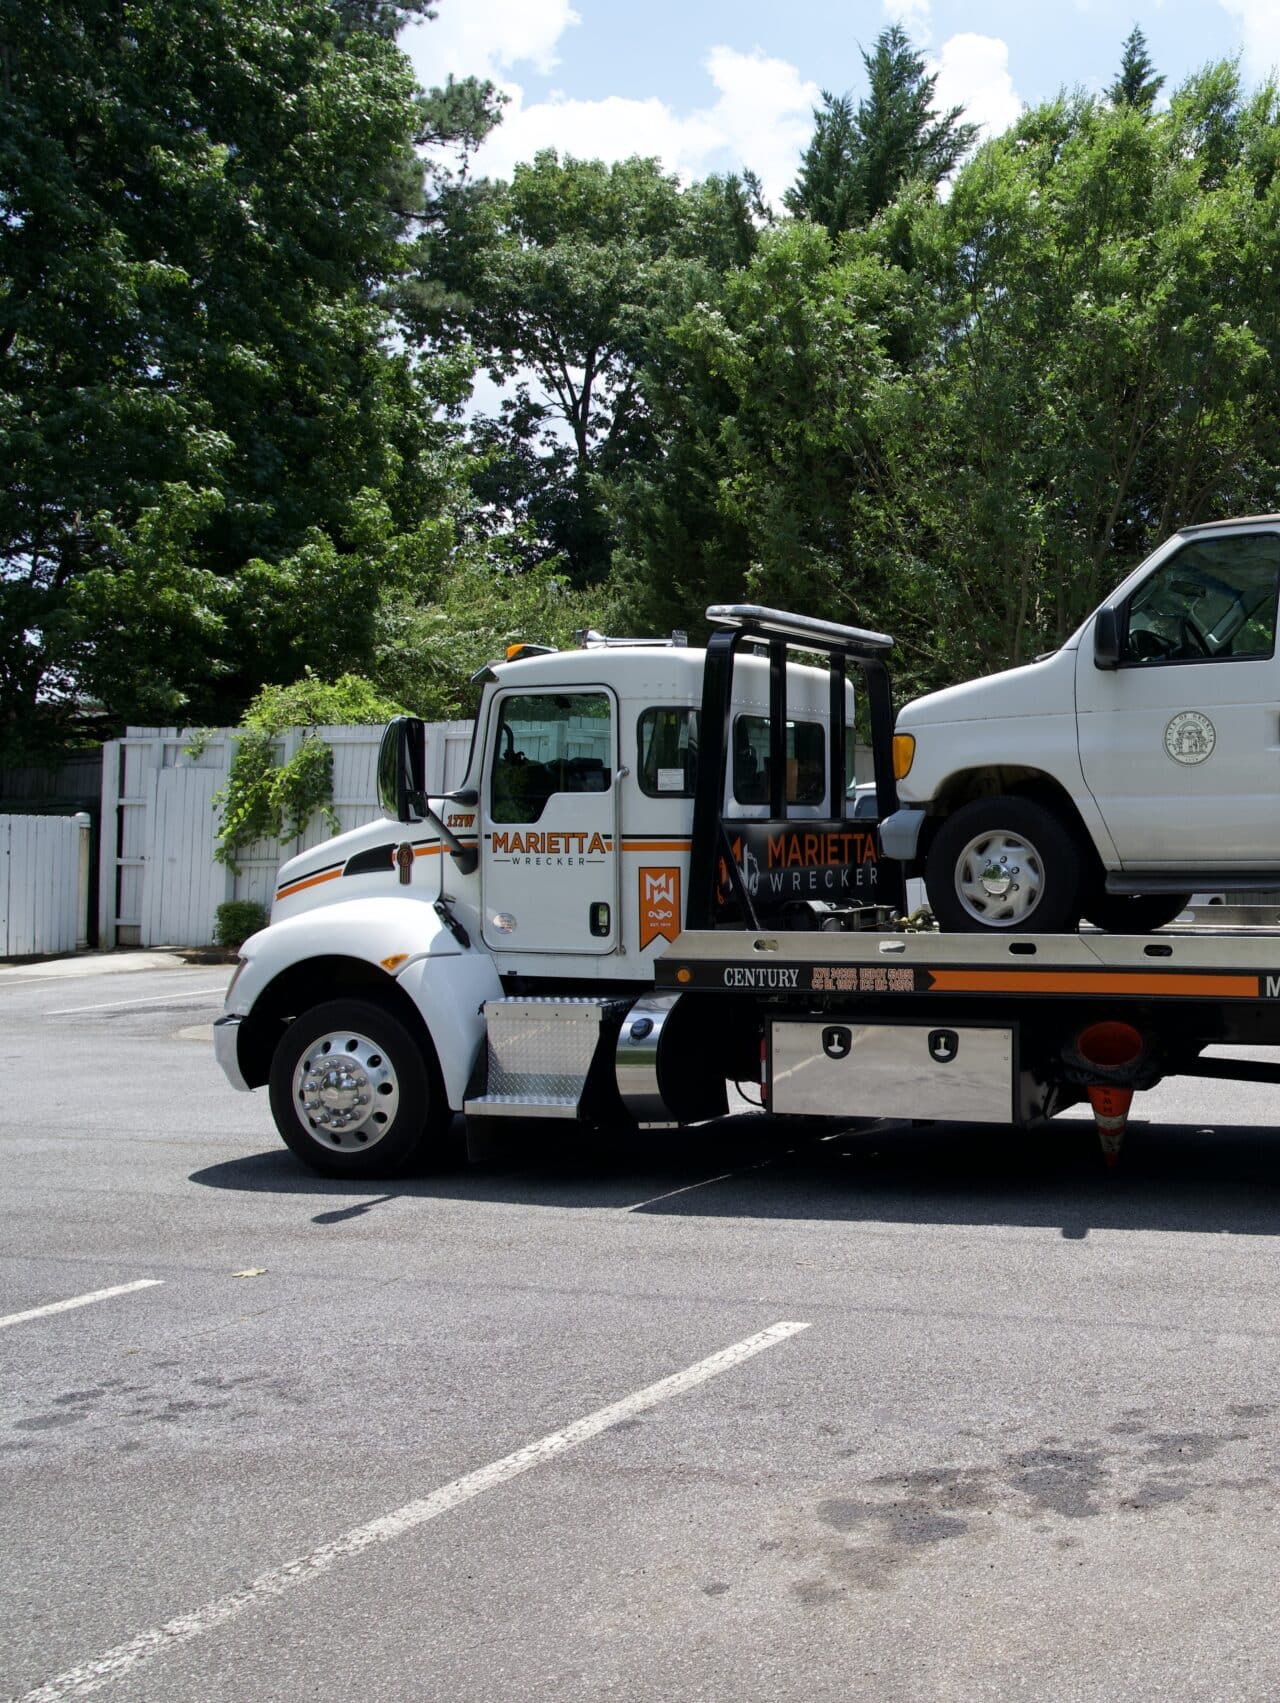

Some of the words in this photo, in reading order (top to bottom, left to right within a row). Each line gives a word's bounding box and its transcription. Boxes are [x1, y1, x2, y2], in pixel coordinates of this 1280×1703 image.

[492, 831, 607, 854] MARIETTA
[768, 833, 877, 868] MARIETTA
[512, 857, 585, 866] WRECKER
[769, 867, 878, 892] WRECKER
[723, 968, 800, 988] CENTURY
